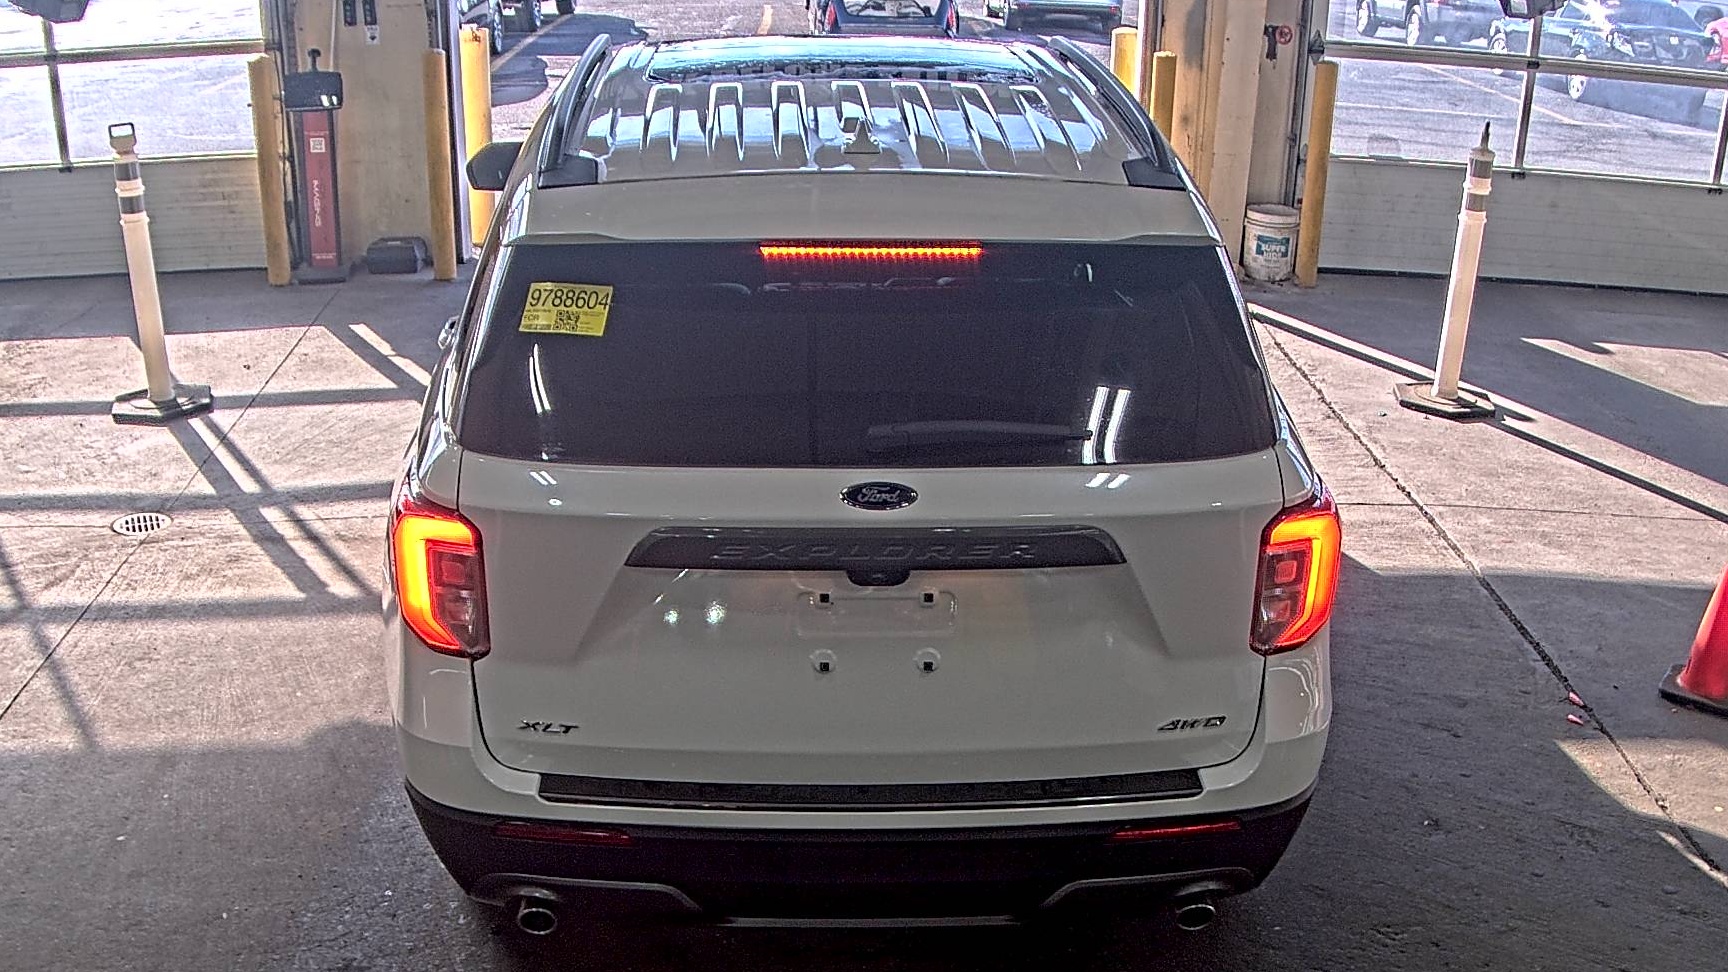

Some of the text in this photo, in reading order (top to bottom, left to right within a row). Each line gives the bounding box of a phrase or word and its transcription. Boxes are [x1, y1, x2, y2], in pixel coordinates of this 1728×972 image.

[530, 288, 610, 310] 9788604
[710, 544, 1036, 560] EXPLORER
[517, 720, 580, 734] XLT
[1157, 716, 1227, 731] 4WD
